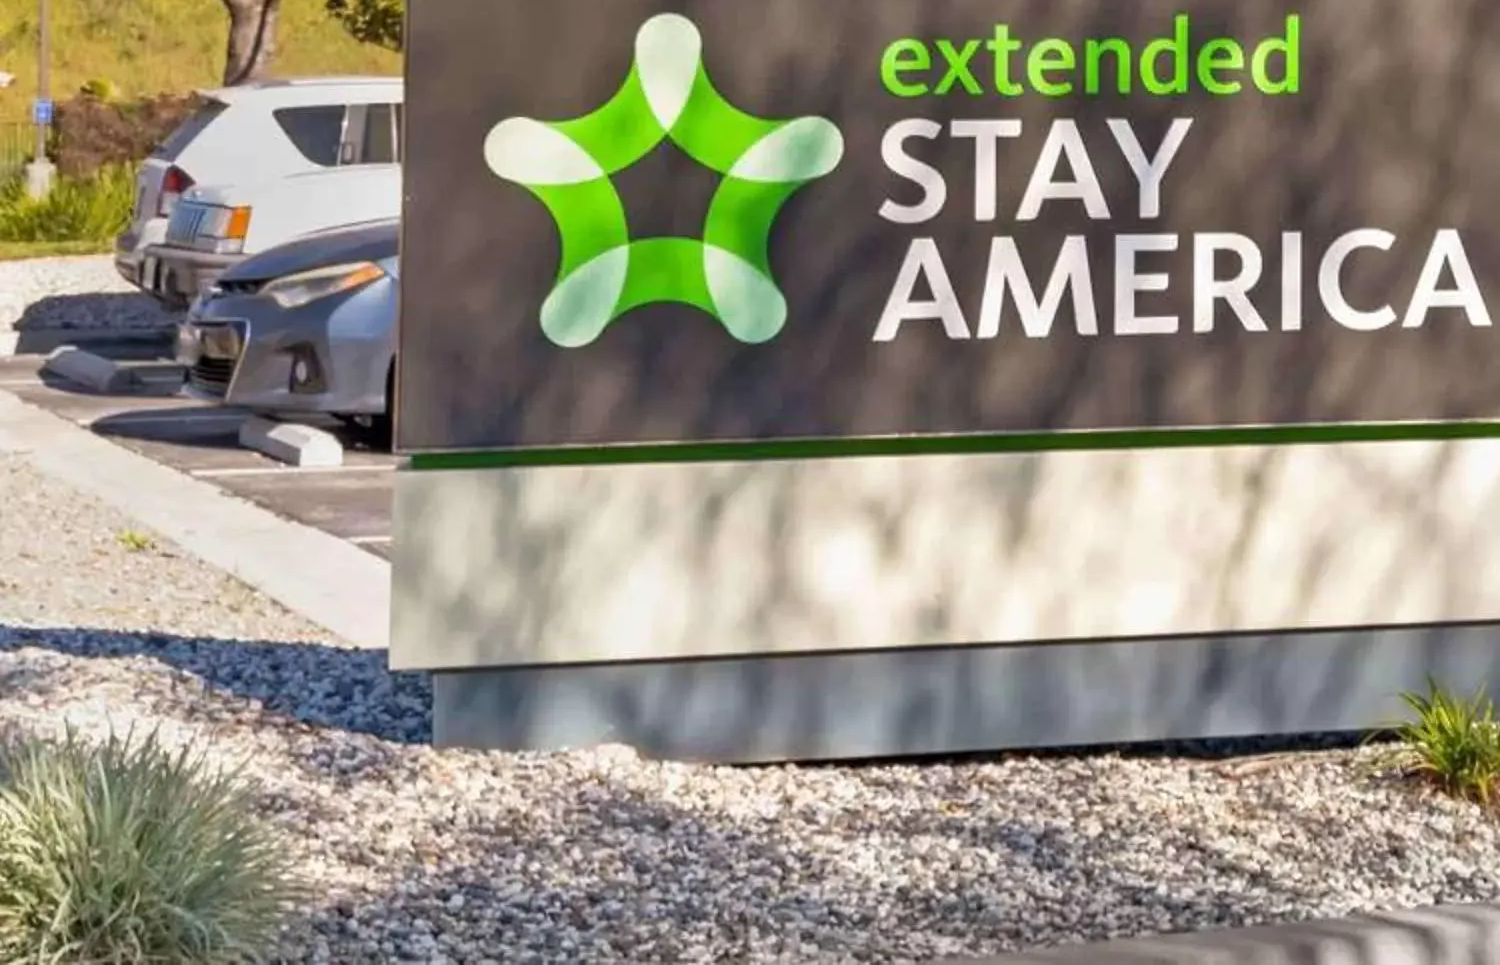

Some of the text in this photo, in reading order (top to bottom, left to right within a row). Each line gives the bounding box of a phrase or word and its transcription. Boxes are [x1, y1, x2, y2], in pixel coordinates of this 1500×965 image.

[880, 12, 1301, 97] extended
[879, 118, 1193, 223] STAY
[873, 228, 1492, 342] AMERICA
